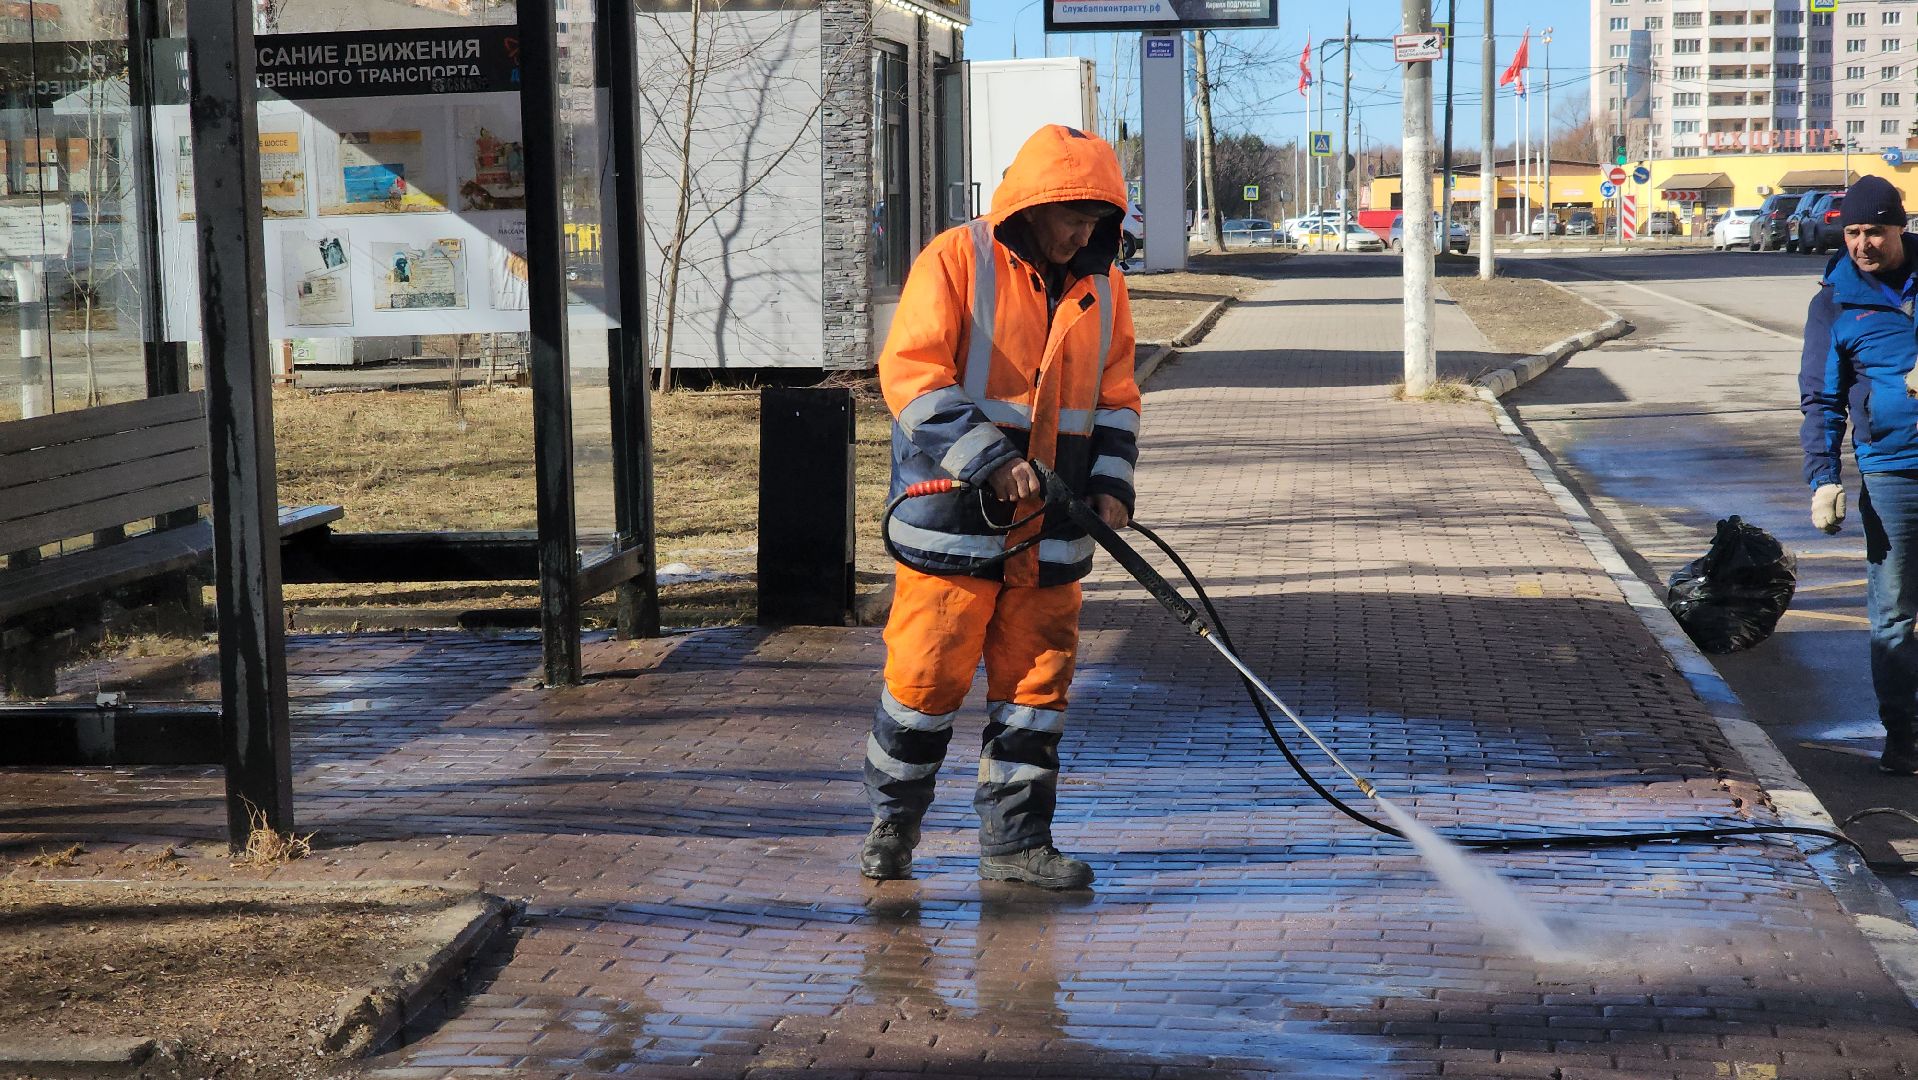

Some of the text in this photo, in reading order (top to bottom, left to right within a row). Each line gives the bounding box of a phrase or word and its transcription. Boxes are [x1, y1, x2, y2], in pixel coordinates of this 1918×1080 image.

[1062, 3, 1161, 14] Службапоконтракту.рф
[344, 38, 481, 66] ДВИЖЕНИЯ
[357, 64, 481, 83] ТРАНСПОРТА
[1699, 128, 1839, 151] ТЕХЦЕНТР
